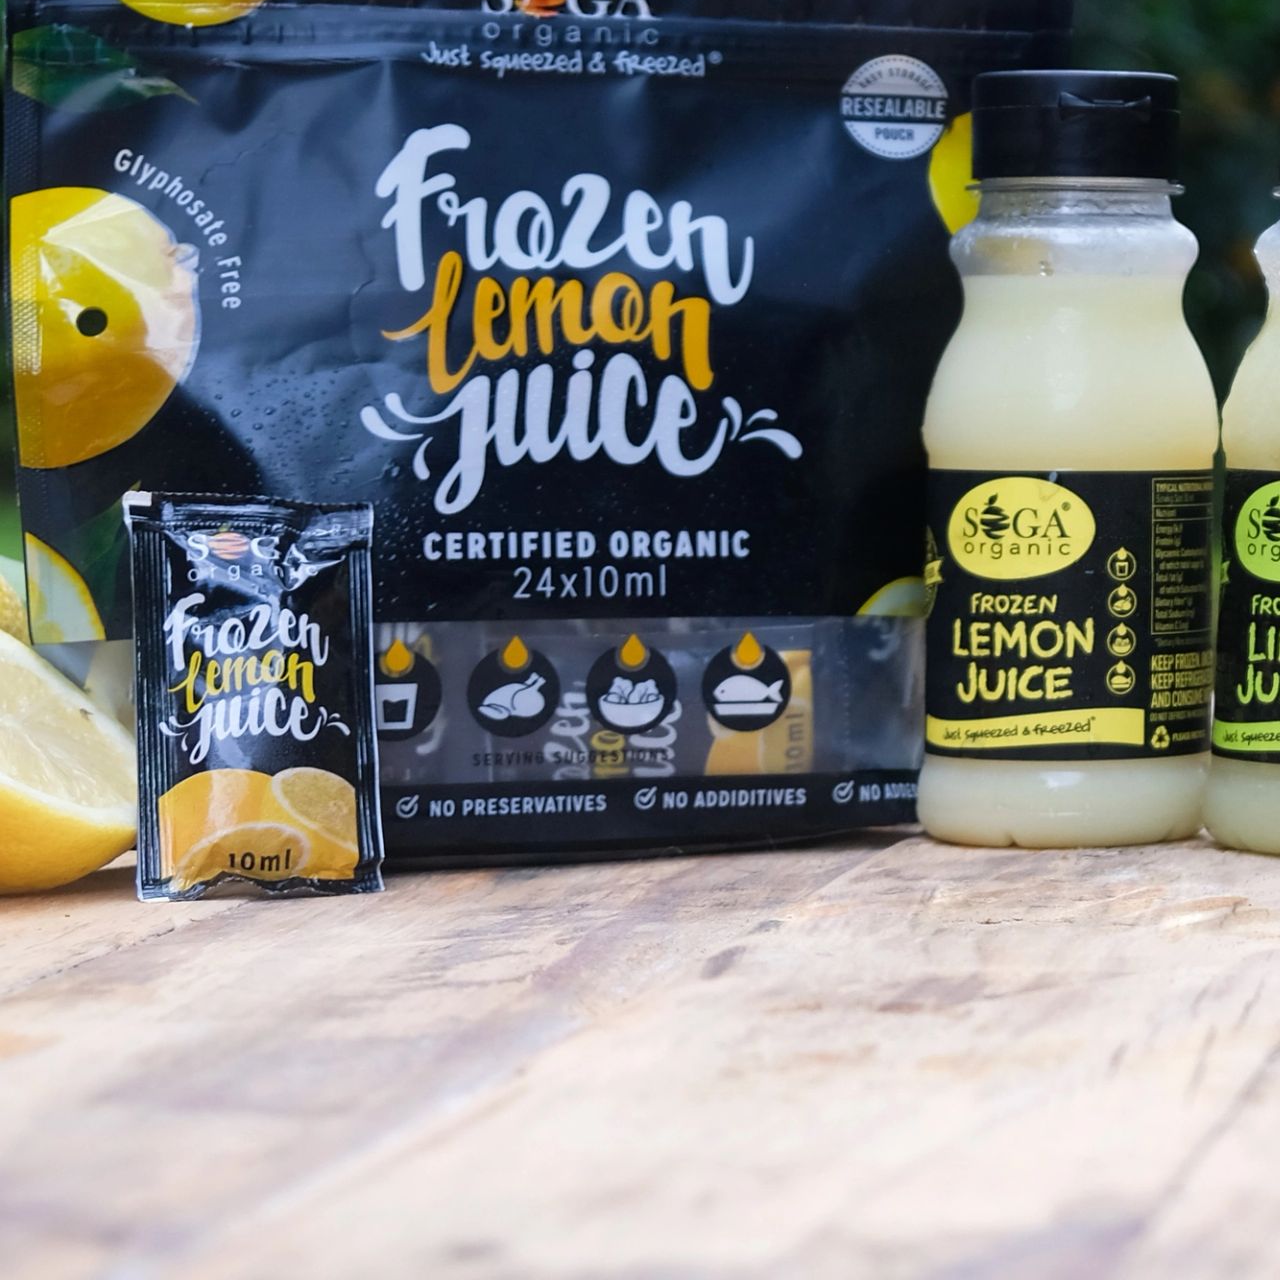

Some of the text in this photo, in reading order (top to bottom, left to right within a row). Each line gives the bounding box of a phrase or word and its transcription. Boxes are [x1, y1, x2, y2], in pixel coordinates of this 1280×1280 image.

[482, 20, 660, 47] organic
[421, 43, 472, 67] Just
[479, 46, 583, 78] squeezed
[841, 95, 947, 120] RESEALABLE
[874, 126, 915, 142] POUCH
[375, 123, 755, 306] Frozen
[113, 148, 242, 310] Glyphosate Free
[380, 250, 716, 395] lemon
[385, 348, 729, 516] juice
[422, 529, 751, 561] CERTIFIED ORGANIC
[963, 537, 1071, 560] organic
[187, 562, 318, 582] organc
[512, 563, 668, 599] 24x10ml
[969, 592, 1059, 615] FROZEN
[163, 593, 330, 671] Frozen
[953, 617, 1095, 659] LEMON
[1151, 654, 1175, 671] KEEP
[168, 649, 317, 713] lemon
[956, 661, 1074, 705] JUICE
[1151, 672, 1175, 690] KEEP
[1151, 690, 1171, 709] AND
[169, 684, 324, 765] juice
[964, 724, 1019, 744] squeezed
[471, 748, 670, 767] SERVING SUGGESTIONS
[429, 793, 608, 818] NO PRESERVATIVES
[662, 787, 808, 810] NO ADDIDITIVES
[858, 783, 882, 802] NO
